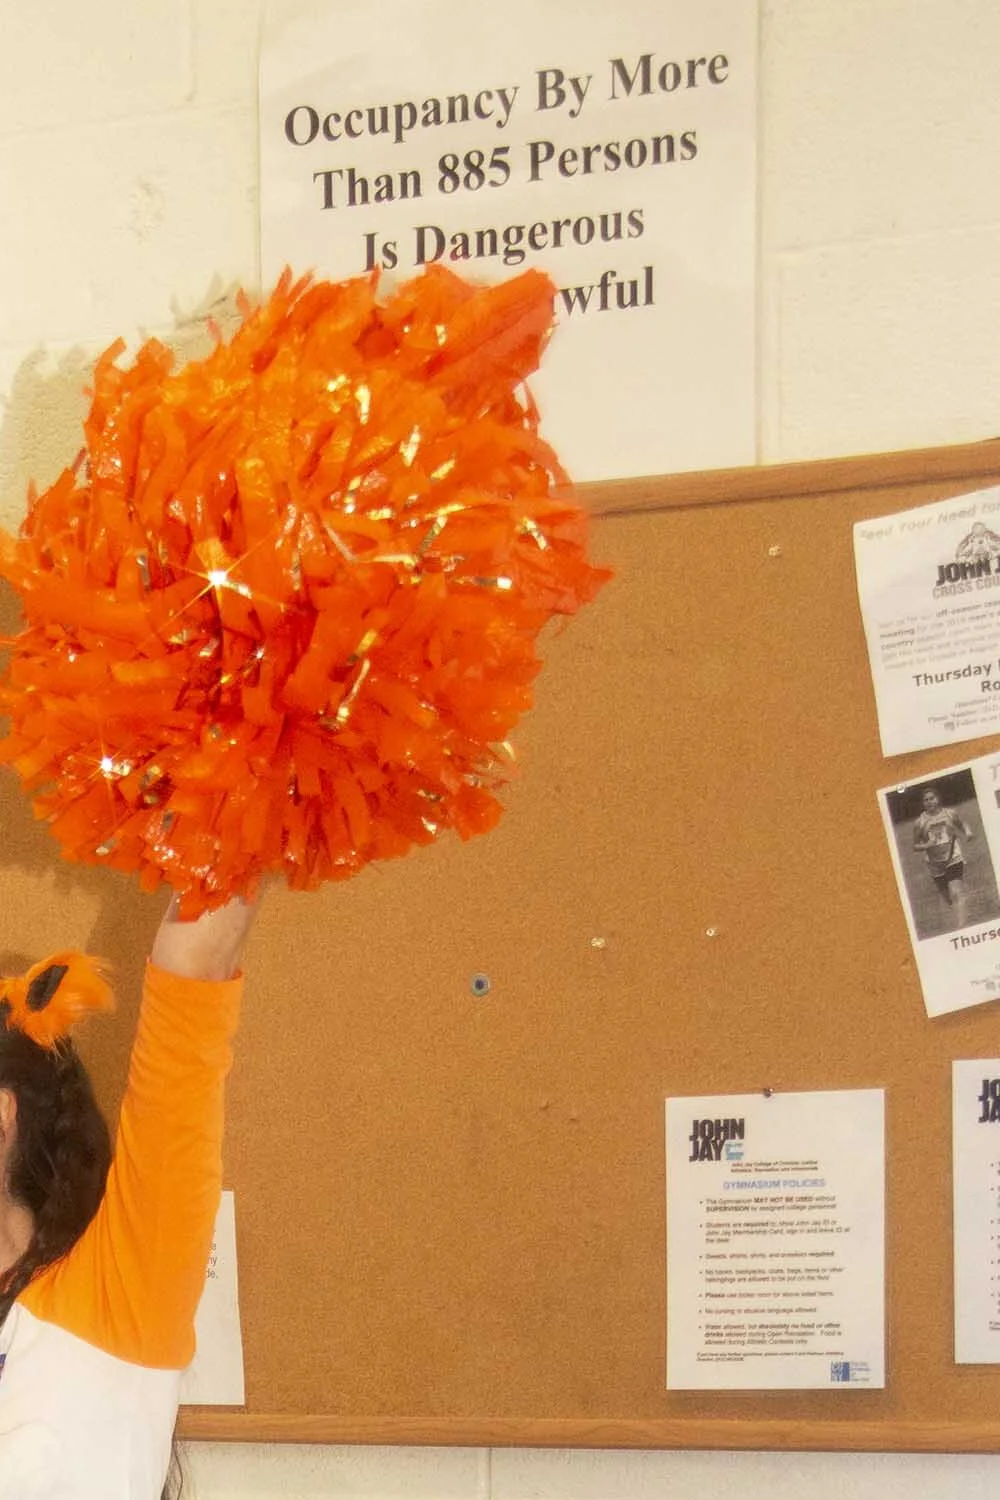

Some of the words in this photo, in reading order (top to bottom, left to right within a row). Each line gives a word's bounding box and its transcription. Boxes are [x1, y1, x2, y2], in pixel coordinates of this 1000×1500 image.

[284, 82, 520, 148] Occupancy
[535, 67, 593, 118] By
[609, 52, 730, 101] More
[313, 167, 422, 211] Than
[437, 146, 512, 195] 885
[527, 129, 699, 183] Persons
[362, 231, 398, 273] Is
[412, 207, 645, 267] Dangerous
[552, 266, 655, 316] wful
[936, 559, 991, 587] JOHN
[932, 580, 973, 600] CROSS
[912, 664, 992, 687] Thursday
[689, 1118, 745, 1141] JOHN
[689, 1137, 726, 1162] JAY
